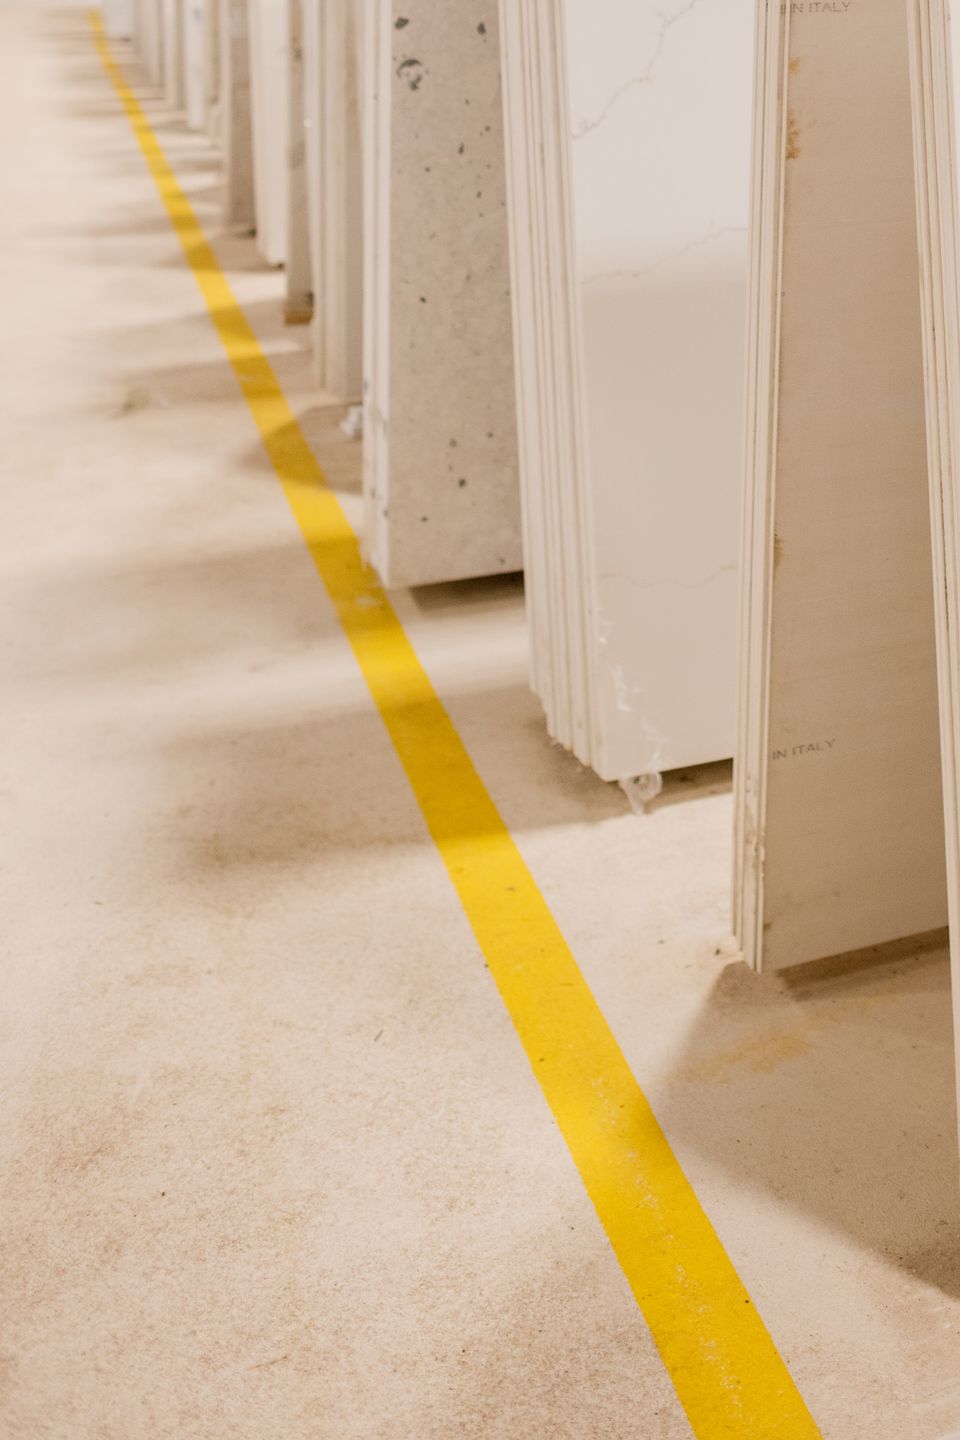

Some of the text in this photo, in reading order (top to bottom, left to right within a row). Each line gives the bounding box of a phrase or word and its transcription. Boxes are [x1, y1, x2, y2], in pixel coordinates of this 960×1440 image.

[808, 1, 851, 13] ITALY
[772, 738, 836, 761] IN ITALY
